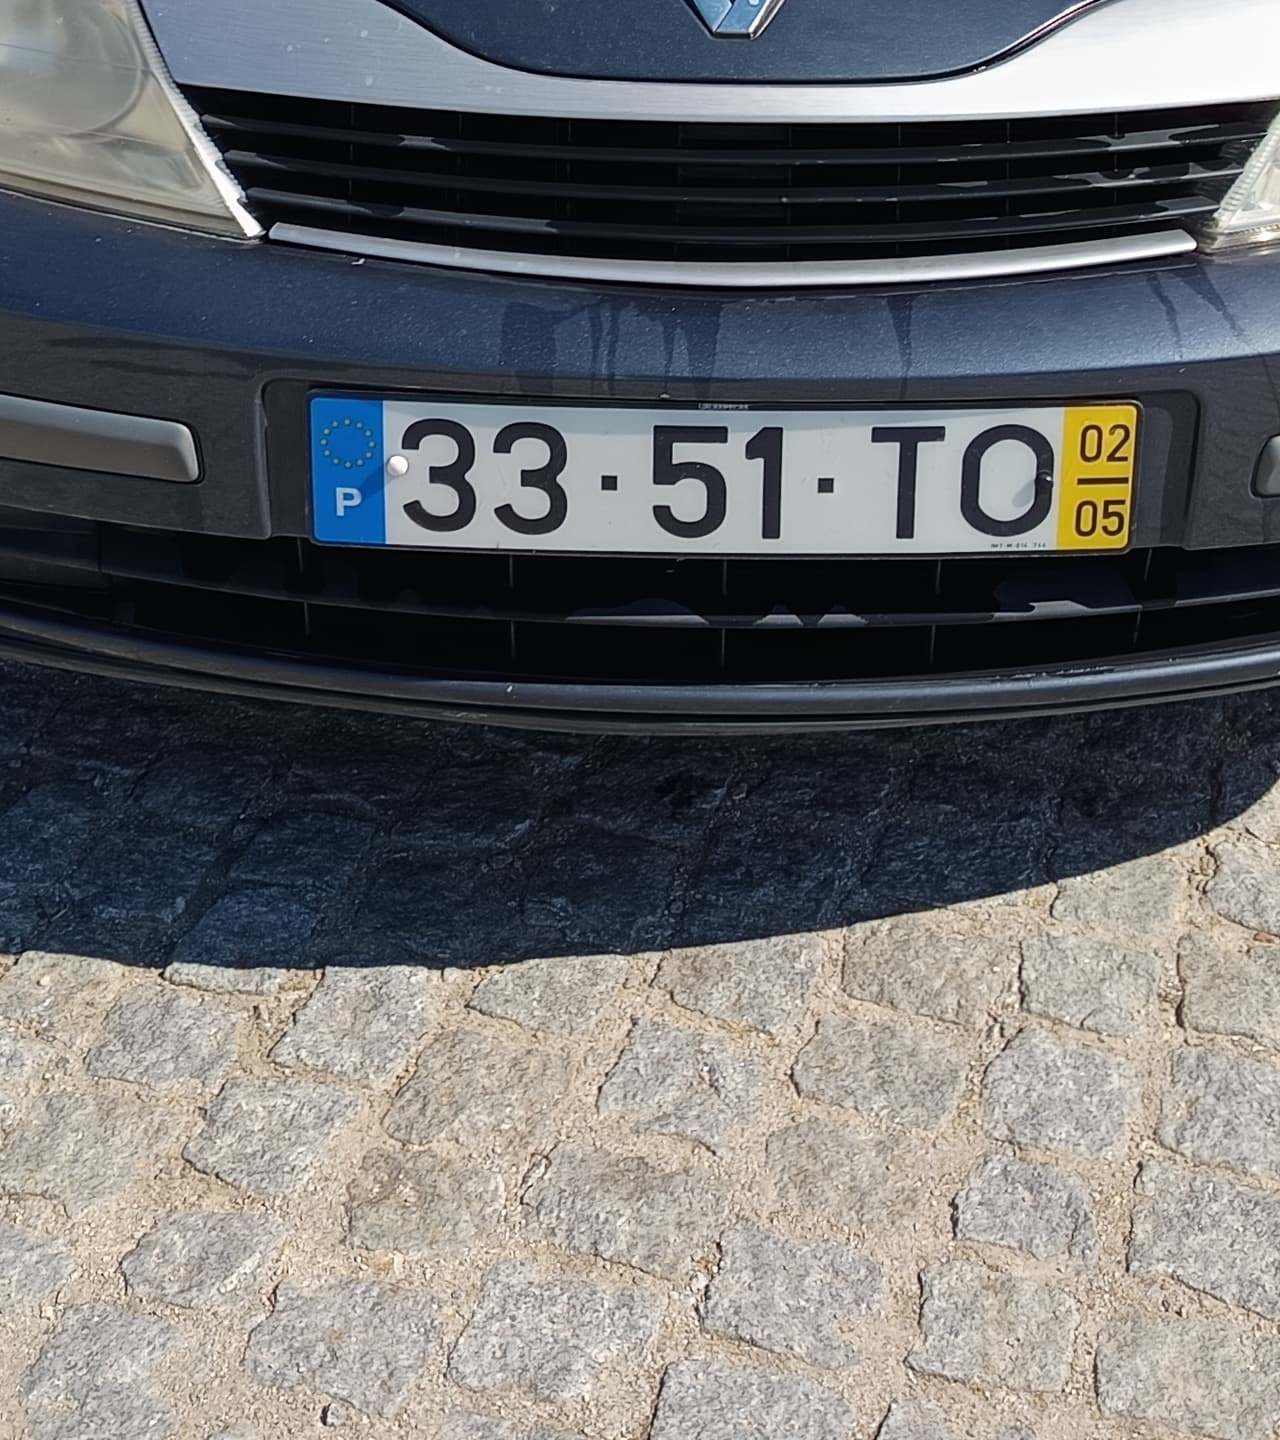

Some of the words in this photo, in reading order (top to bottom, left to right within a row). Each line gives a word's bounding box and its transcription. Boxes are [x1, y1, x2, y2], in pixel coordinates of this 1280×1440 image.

[1080, 424, 1130, 463] 02
[335, 486, 362, 517] P
[1075, 499, 1125, 537] 05
